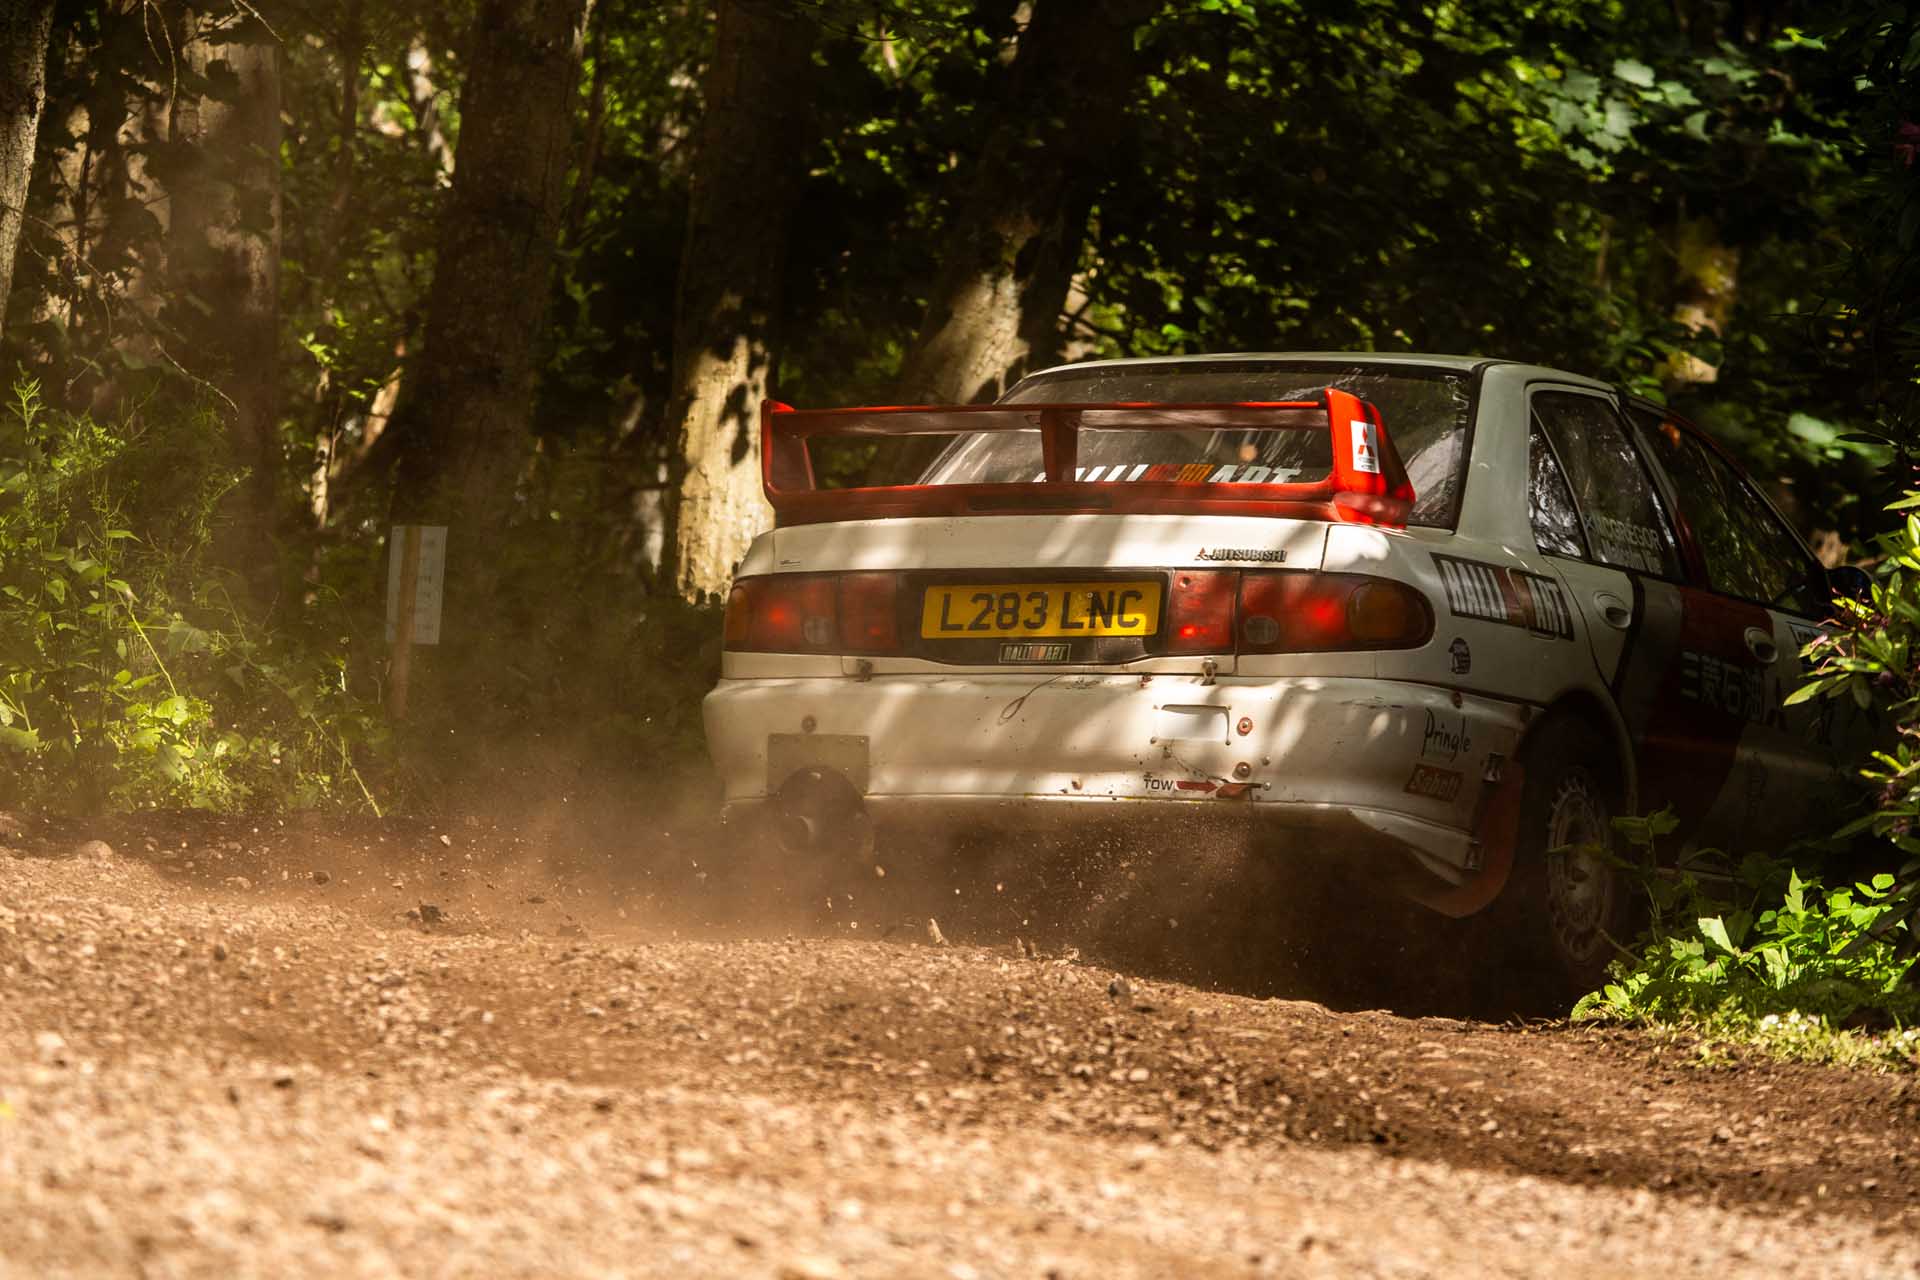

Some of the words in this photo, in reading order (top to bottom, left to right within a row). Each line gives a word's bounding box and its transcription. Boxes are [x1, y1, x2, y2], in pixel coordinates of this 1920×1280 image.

[1210, 548, 1288, 562] MITSUBISHI
[940, 591, 1047, 632] L283
[1059, 590, 1143, 630] LNC
[1422, 706, 1472, 763] Pringle
[1144, 778, 1174, 791] TOW
